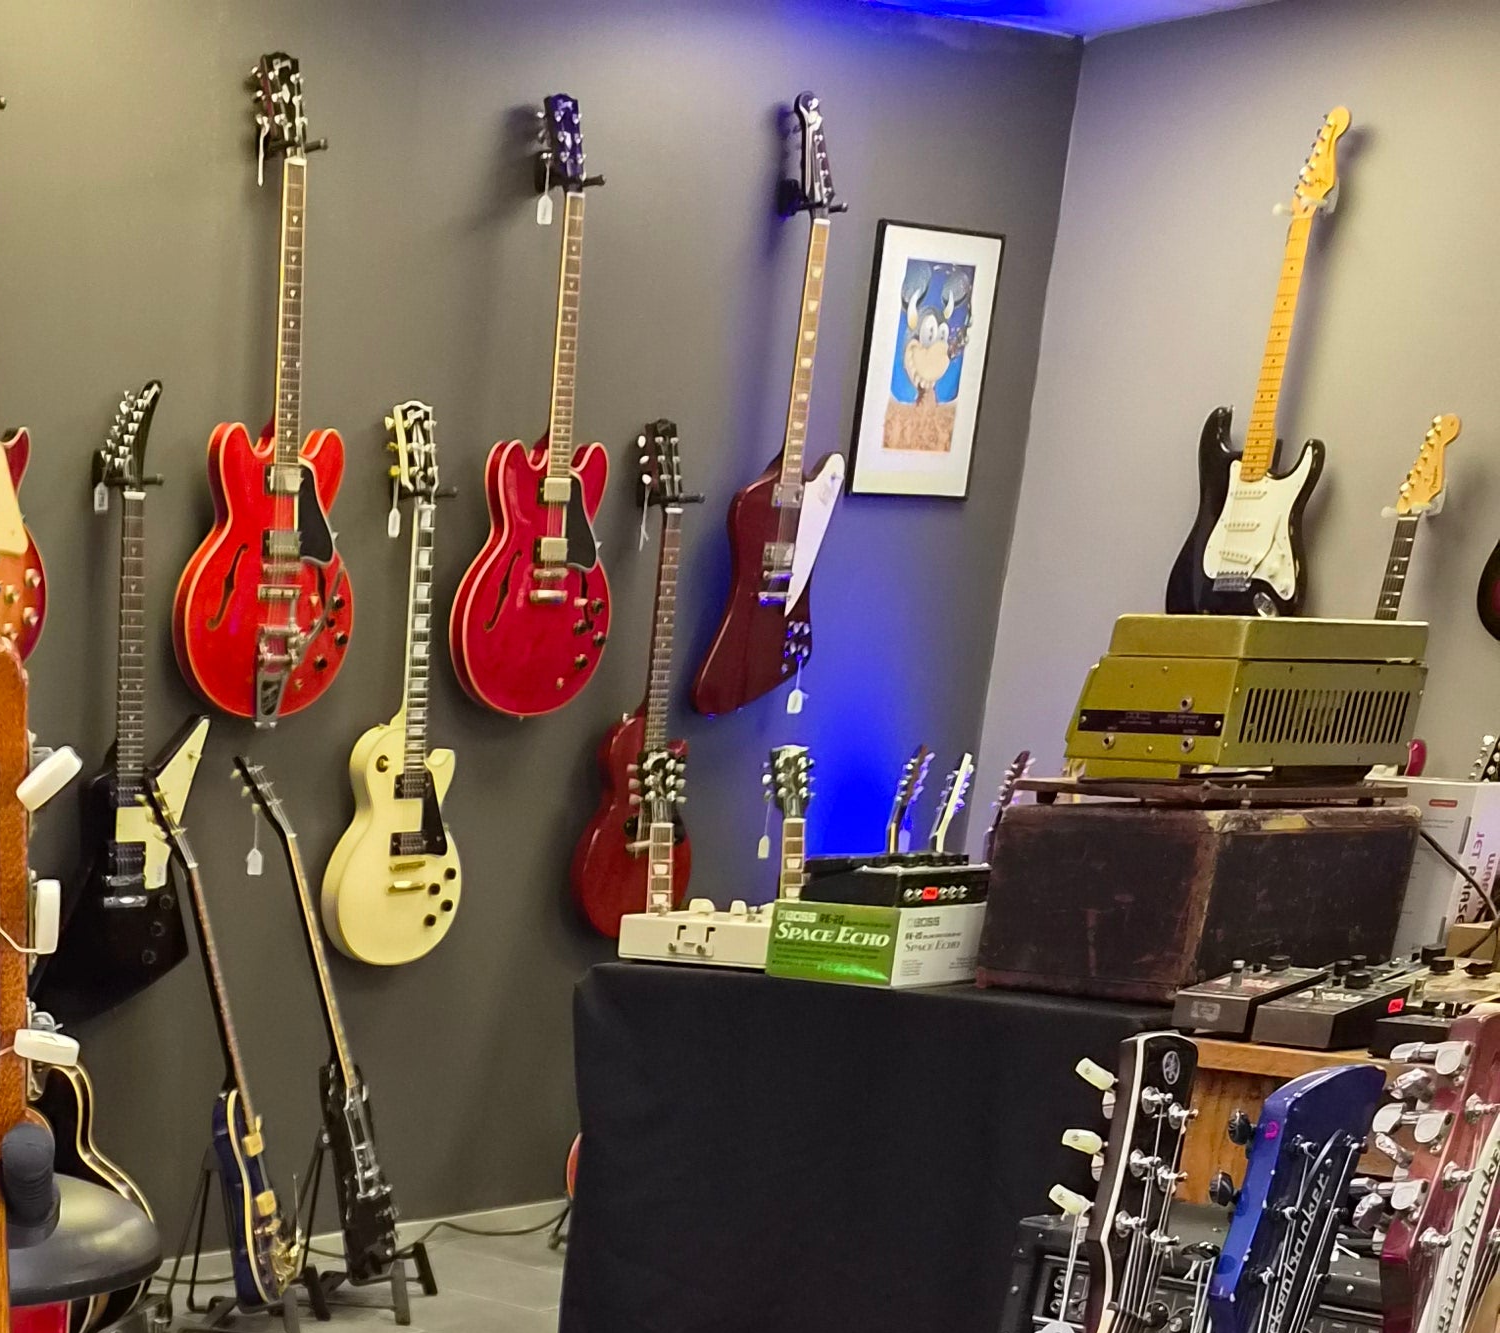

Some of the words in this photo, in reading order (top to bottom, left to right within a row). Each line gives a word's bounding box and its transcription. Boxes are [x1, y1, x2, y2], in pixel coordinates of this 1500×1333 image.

[1471, 831, 1485, 858] JET
[775, 921, 835, 942] SPACE
[835, 926, 890, 947] ECHO
